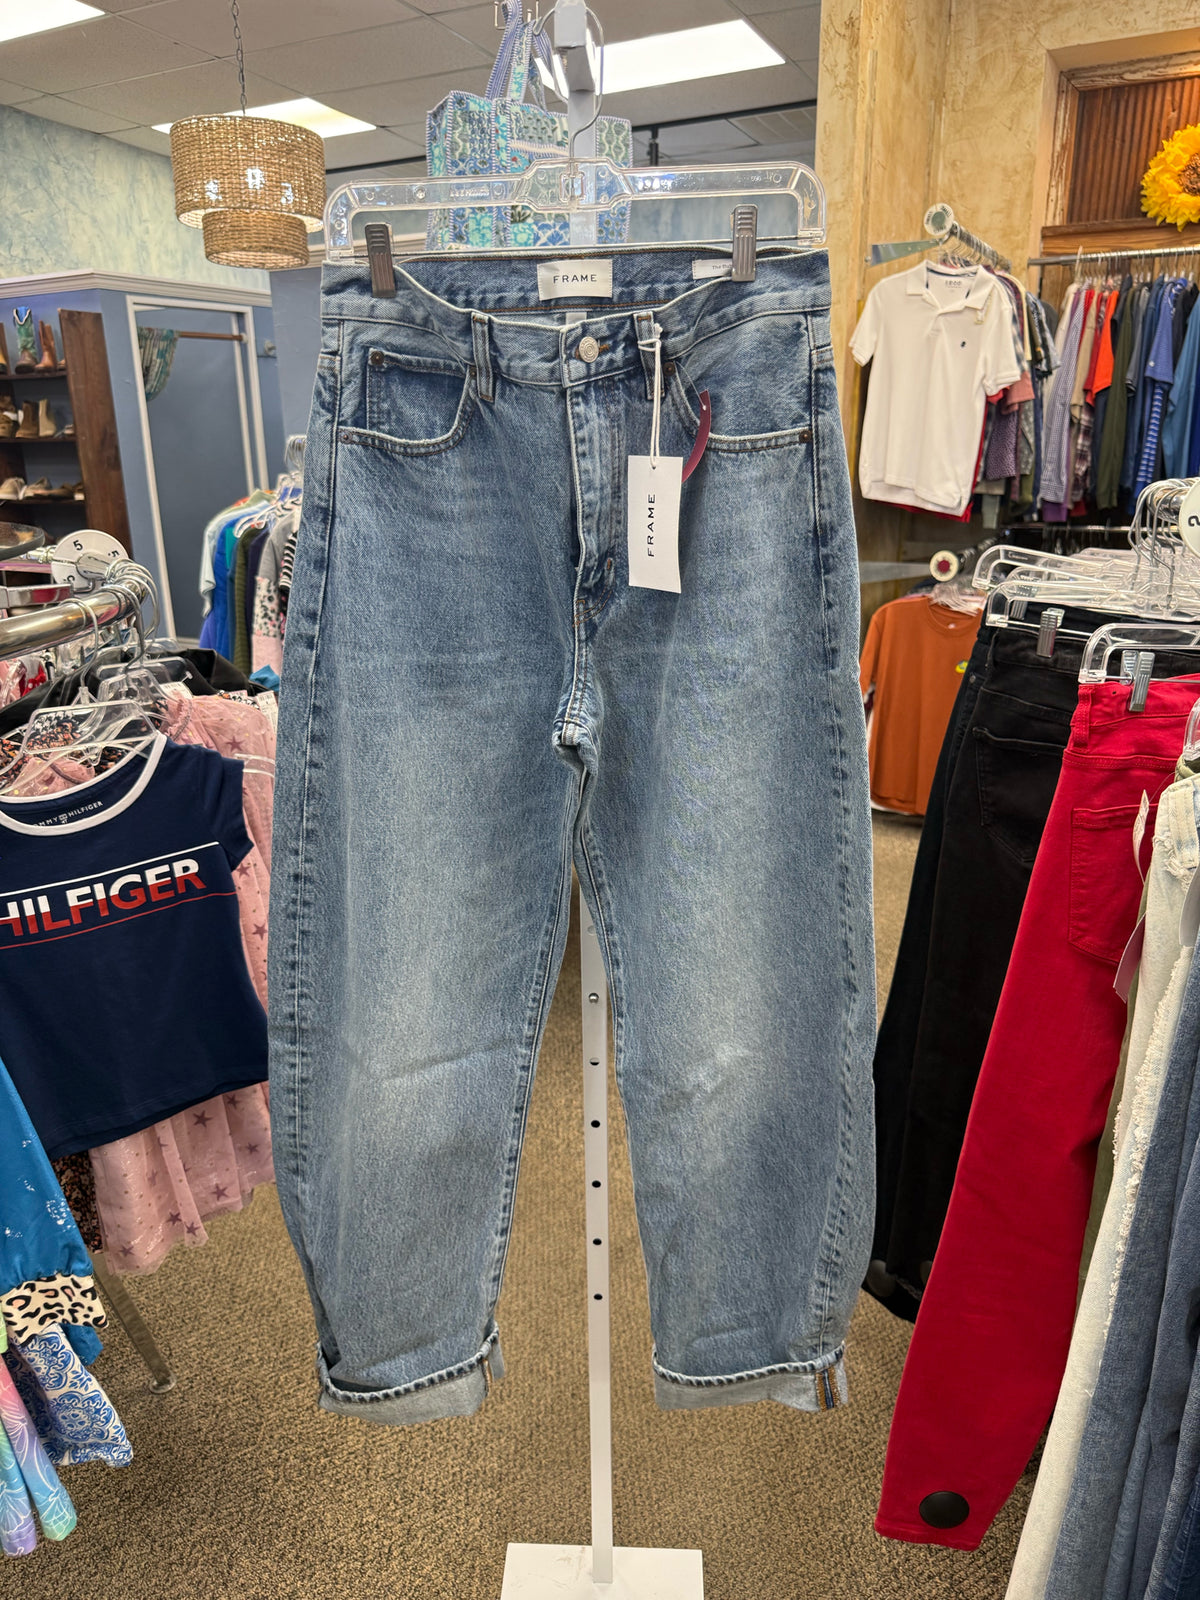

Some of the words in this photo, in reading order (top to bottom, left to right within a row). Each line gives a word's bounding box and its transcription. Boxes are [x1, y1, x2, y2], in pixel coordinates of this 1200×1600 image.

[553, 274, 597, 284] FRAME
[647, 494, 656, 557] FRAME
[73, 540, 83, 551] 5
[68, 801, 103, 817] HILFIGER
[0, 858, 207, 936] HILFIGER
